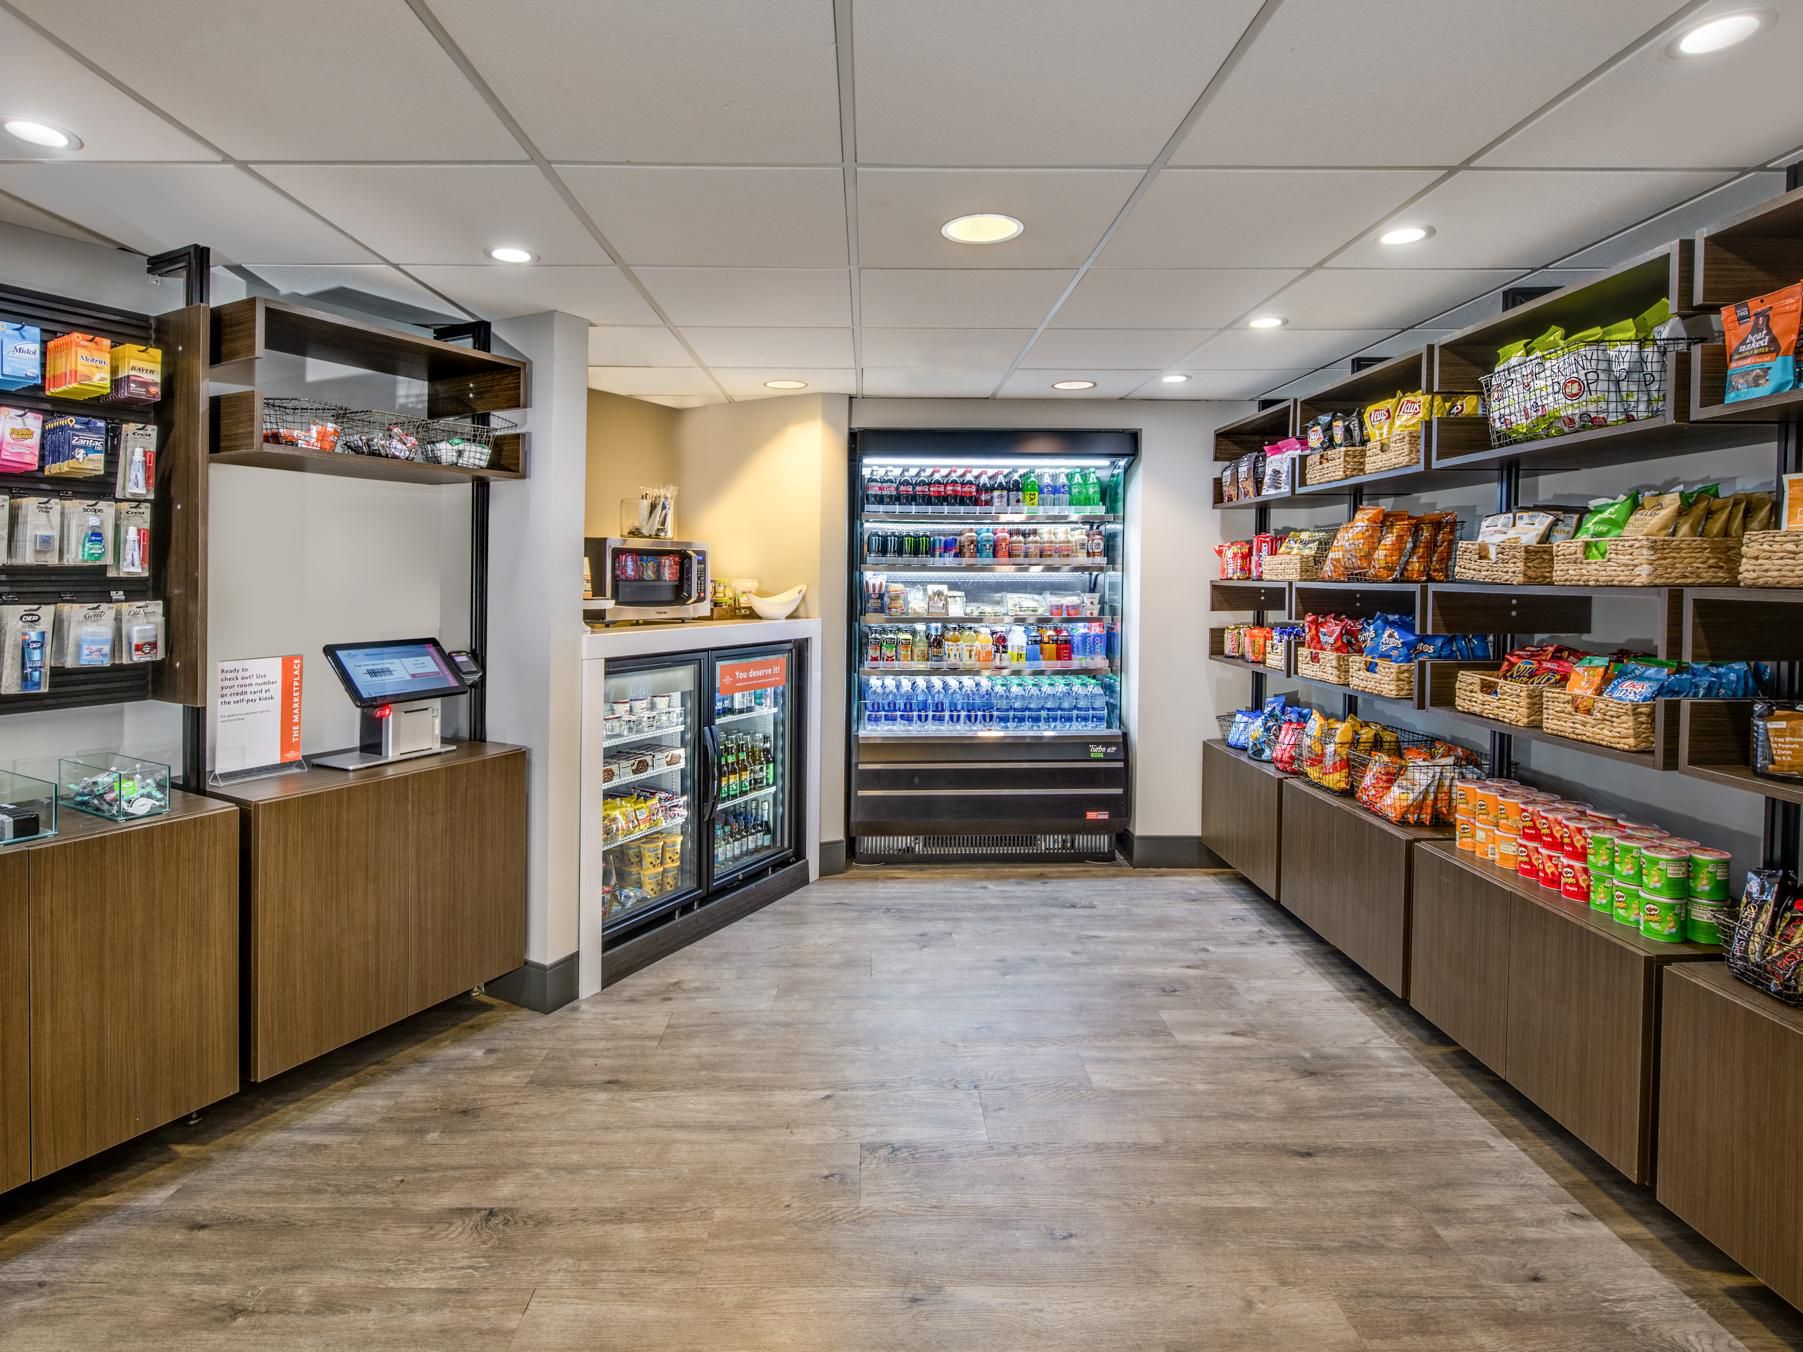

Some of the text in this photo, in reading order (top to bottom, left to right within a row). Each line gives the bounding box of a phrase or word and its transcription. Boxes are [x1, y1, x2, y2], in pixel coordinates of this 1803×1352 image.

[1746, 330, 1767, 343] bear
[1739, 337, 1769, 352] naked
[12, 345, 37, 356] Midol
[79, 354, 107, 366] Motrin
[129, 366, 156, 375] BAYER
[9, 427, 33, 435] Pepto
[71, 436, 104, 447] Zantac
[735, 670, 748, 680] You
[748, 667, 772, 678] deserve
[772, 665, 780, 674] it!
[220, 684, 236, 692] your
[229, 690, 248, 698] credit
[232, 697, 257, 705] self-pay
[292, 658, 301, 743] THE MARKETPLACE
[1088, 744, 1106, 753] Turbo
